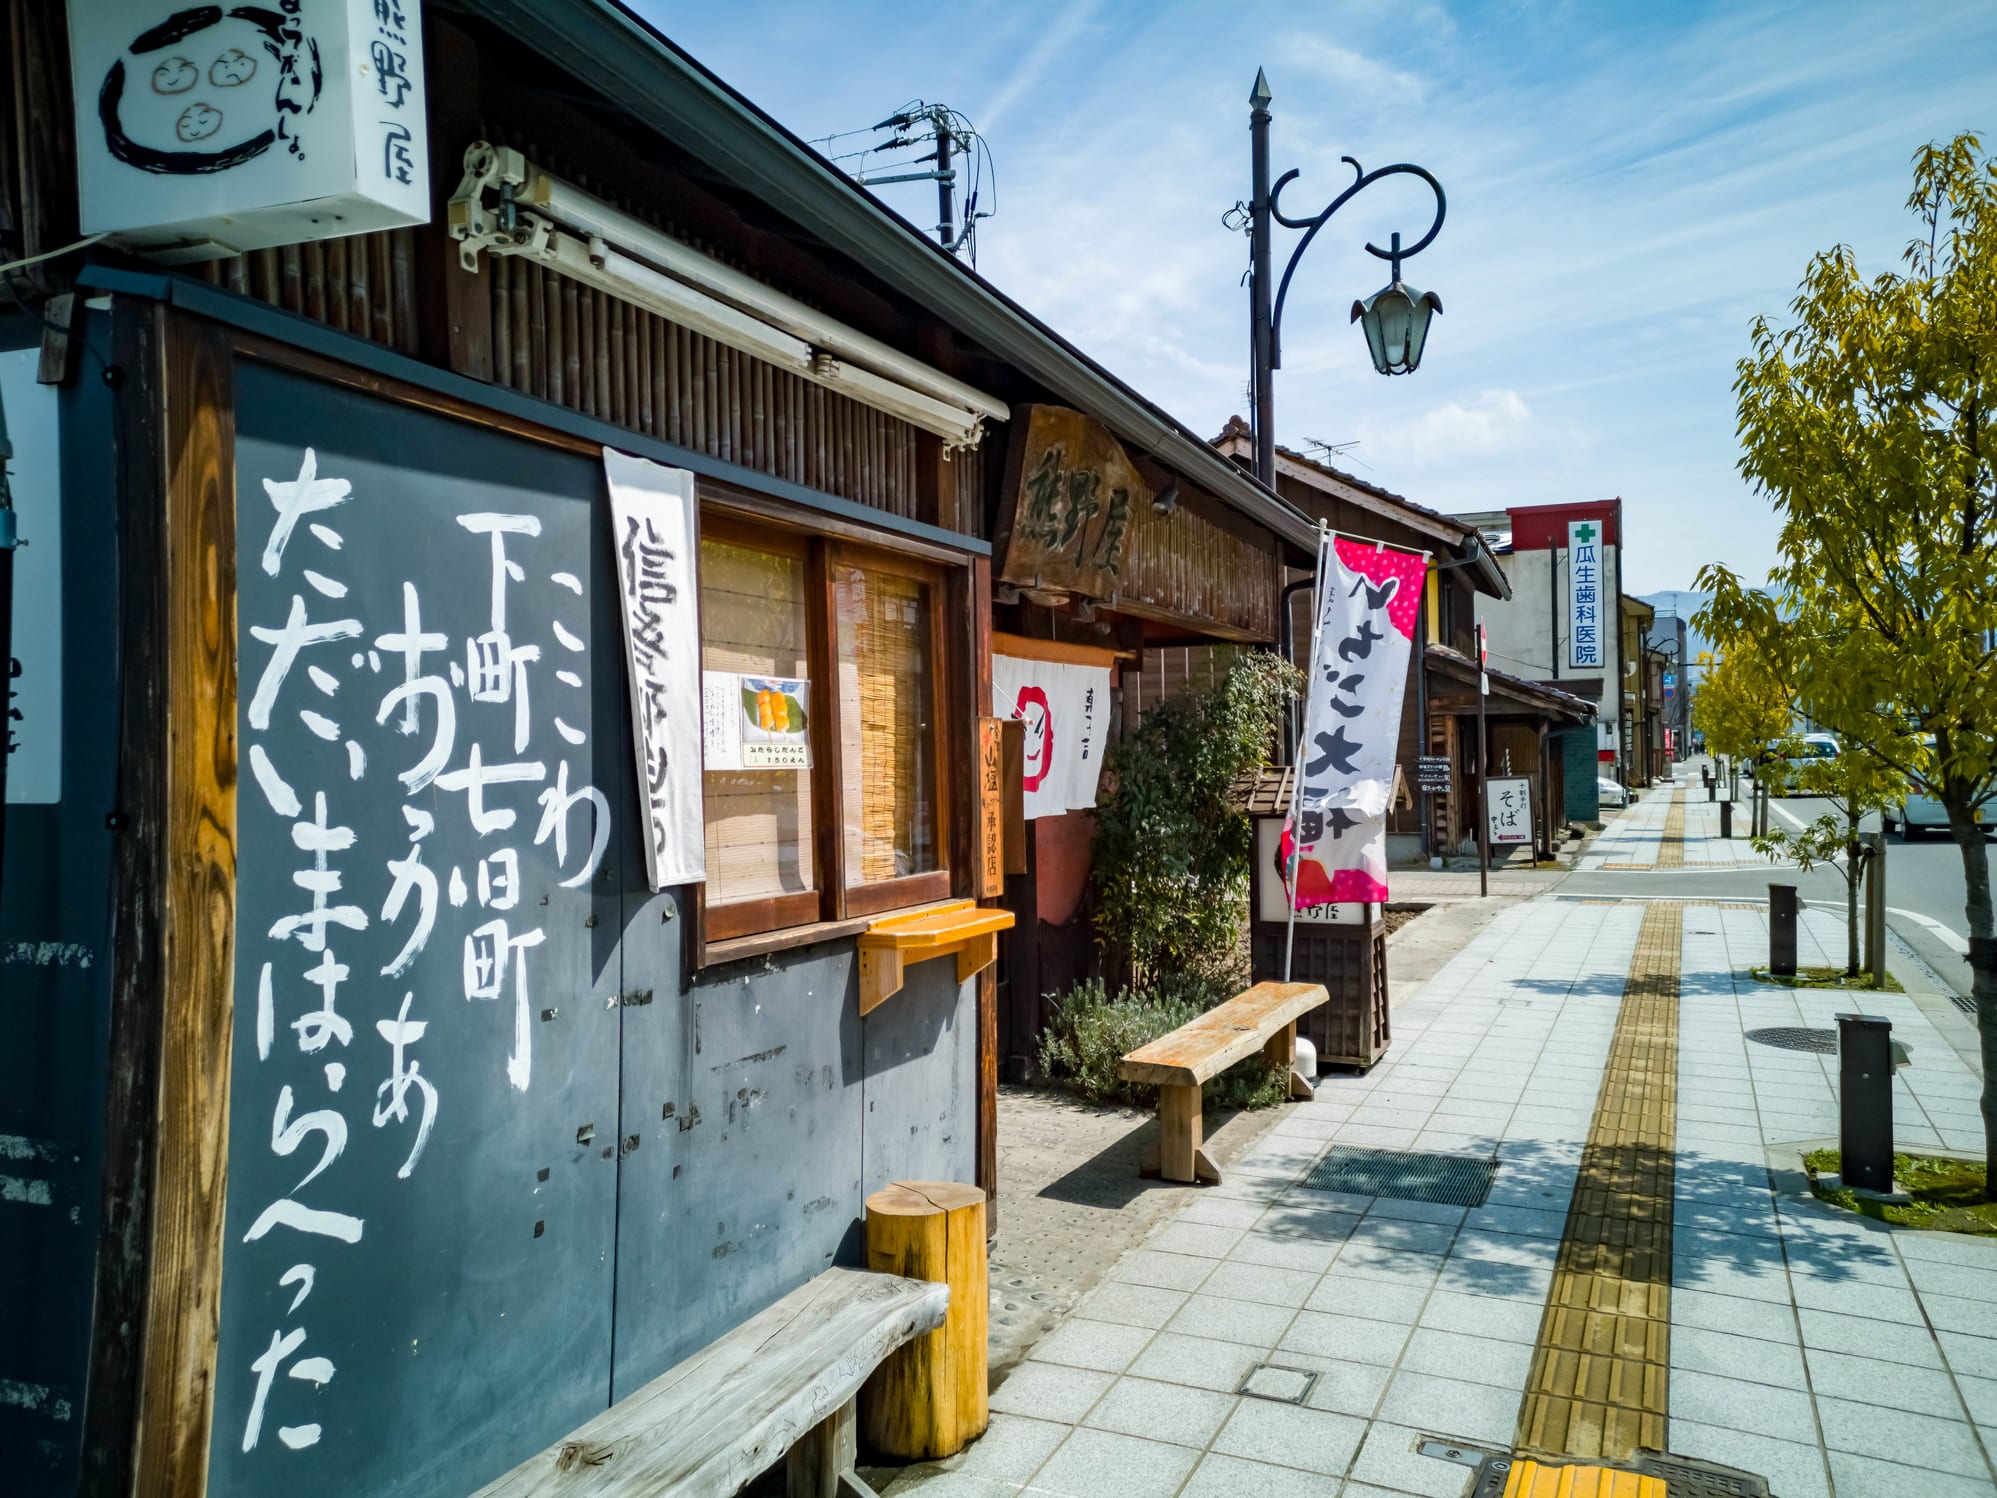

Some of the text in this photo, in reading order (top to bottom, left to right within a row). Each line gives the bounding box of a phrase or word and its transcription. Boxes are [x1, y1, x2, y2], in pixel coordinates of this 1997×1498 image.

[1575, 545, 1597, 664] 瓜生歯科医院
[1500, 790, 1520, 827] そば
